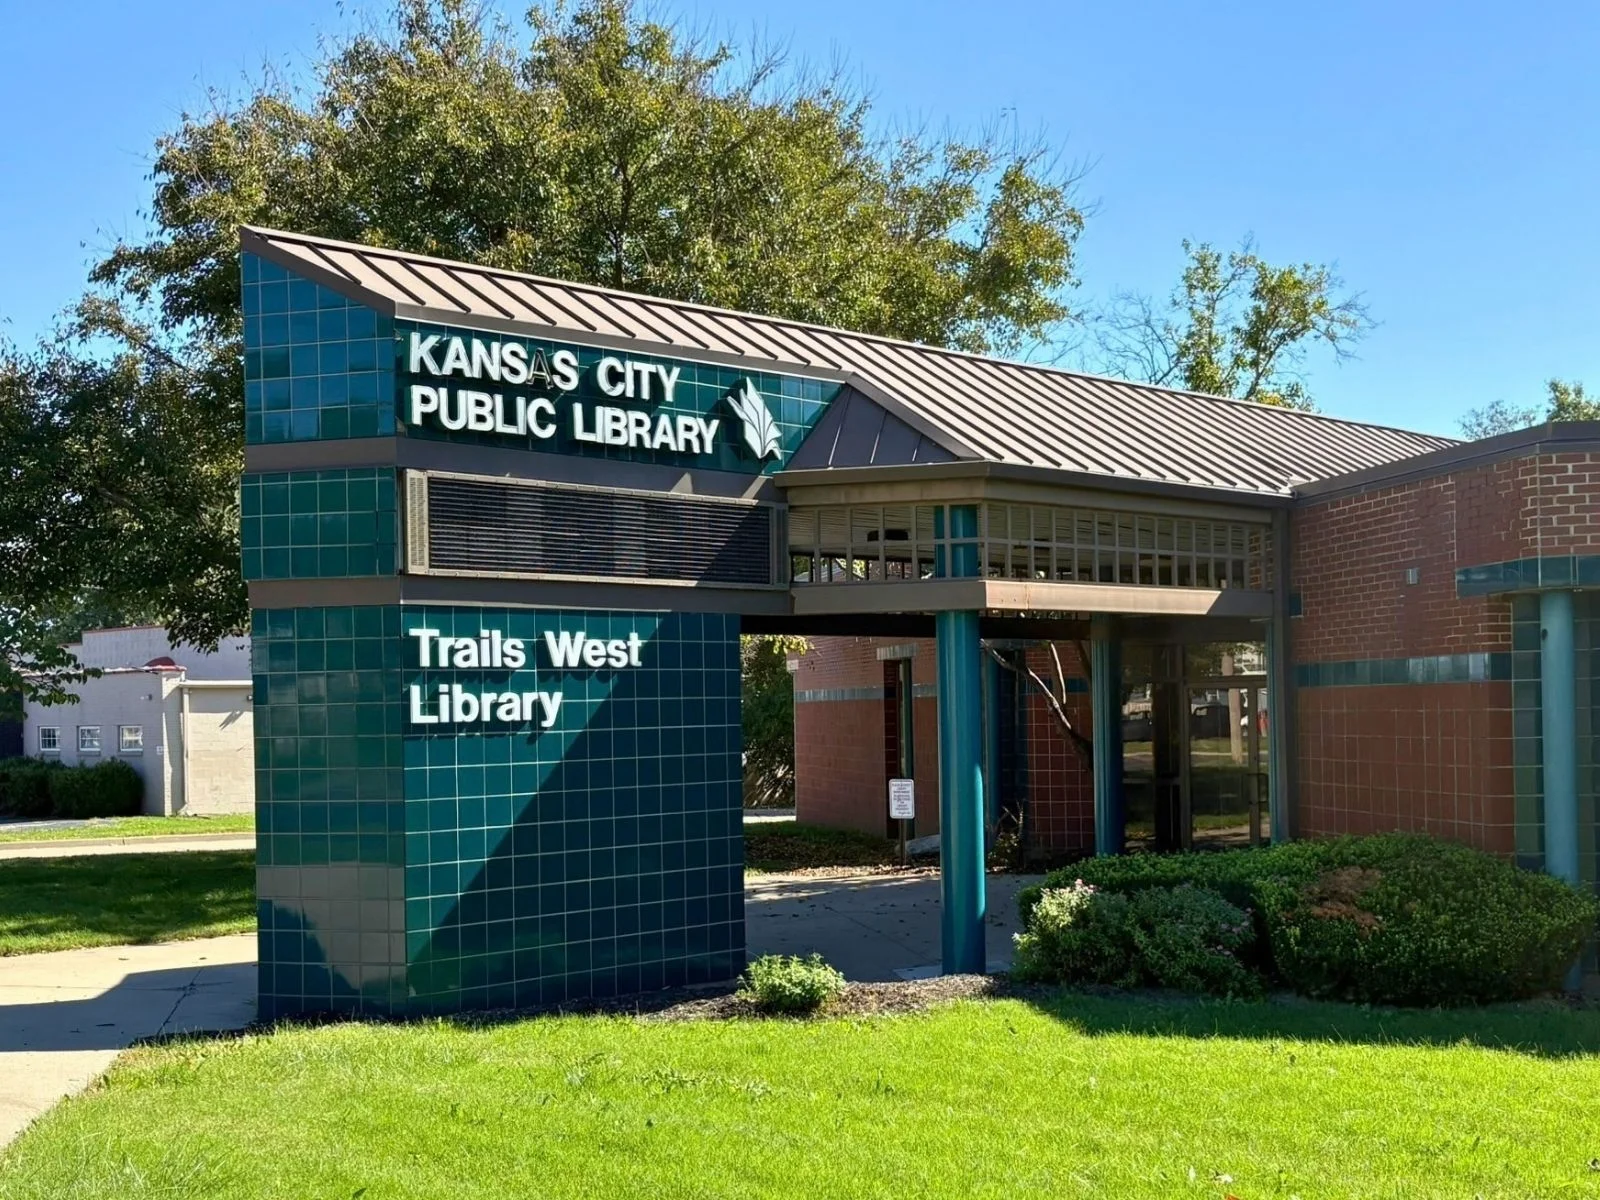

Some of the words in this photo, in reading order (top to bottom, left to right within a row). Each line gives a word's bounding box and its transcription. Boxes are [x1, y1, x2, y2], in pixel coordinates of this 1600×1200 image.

[409, 332, 579, 391] KANSAS
[597, 356, 681, 402] CITY
[410, 385, 557, 439] PUBLIC
[572, 402, 720, 454] LIBRARY
[408, 628, 526, 668] Trails
[543, 631, 643, 668] West
[409, 683, 563, 728] Library
